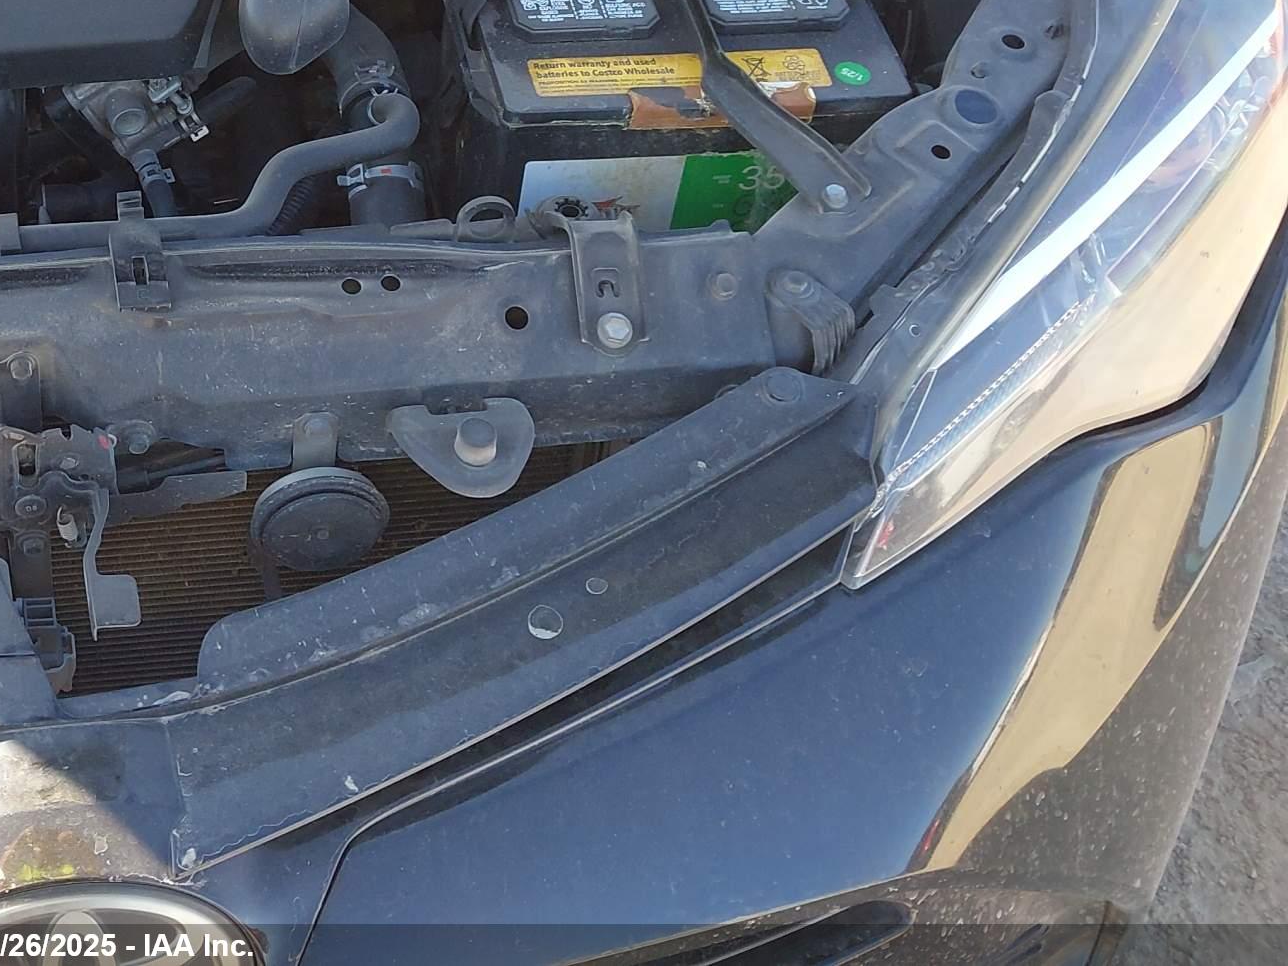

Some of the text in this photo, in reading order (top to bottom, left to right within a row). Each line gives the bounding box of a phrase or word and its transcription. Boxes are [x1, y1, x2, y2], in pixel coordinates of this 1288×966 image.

[533, 58, 656, 70] Return warranty and used
[536, 70, 579, 78] batteries
[592, 68, 623, 77] Costco
[624, 67, 675, 76] Wholesale
[738, 165, 785, 190] 35
